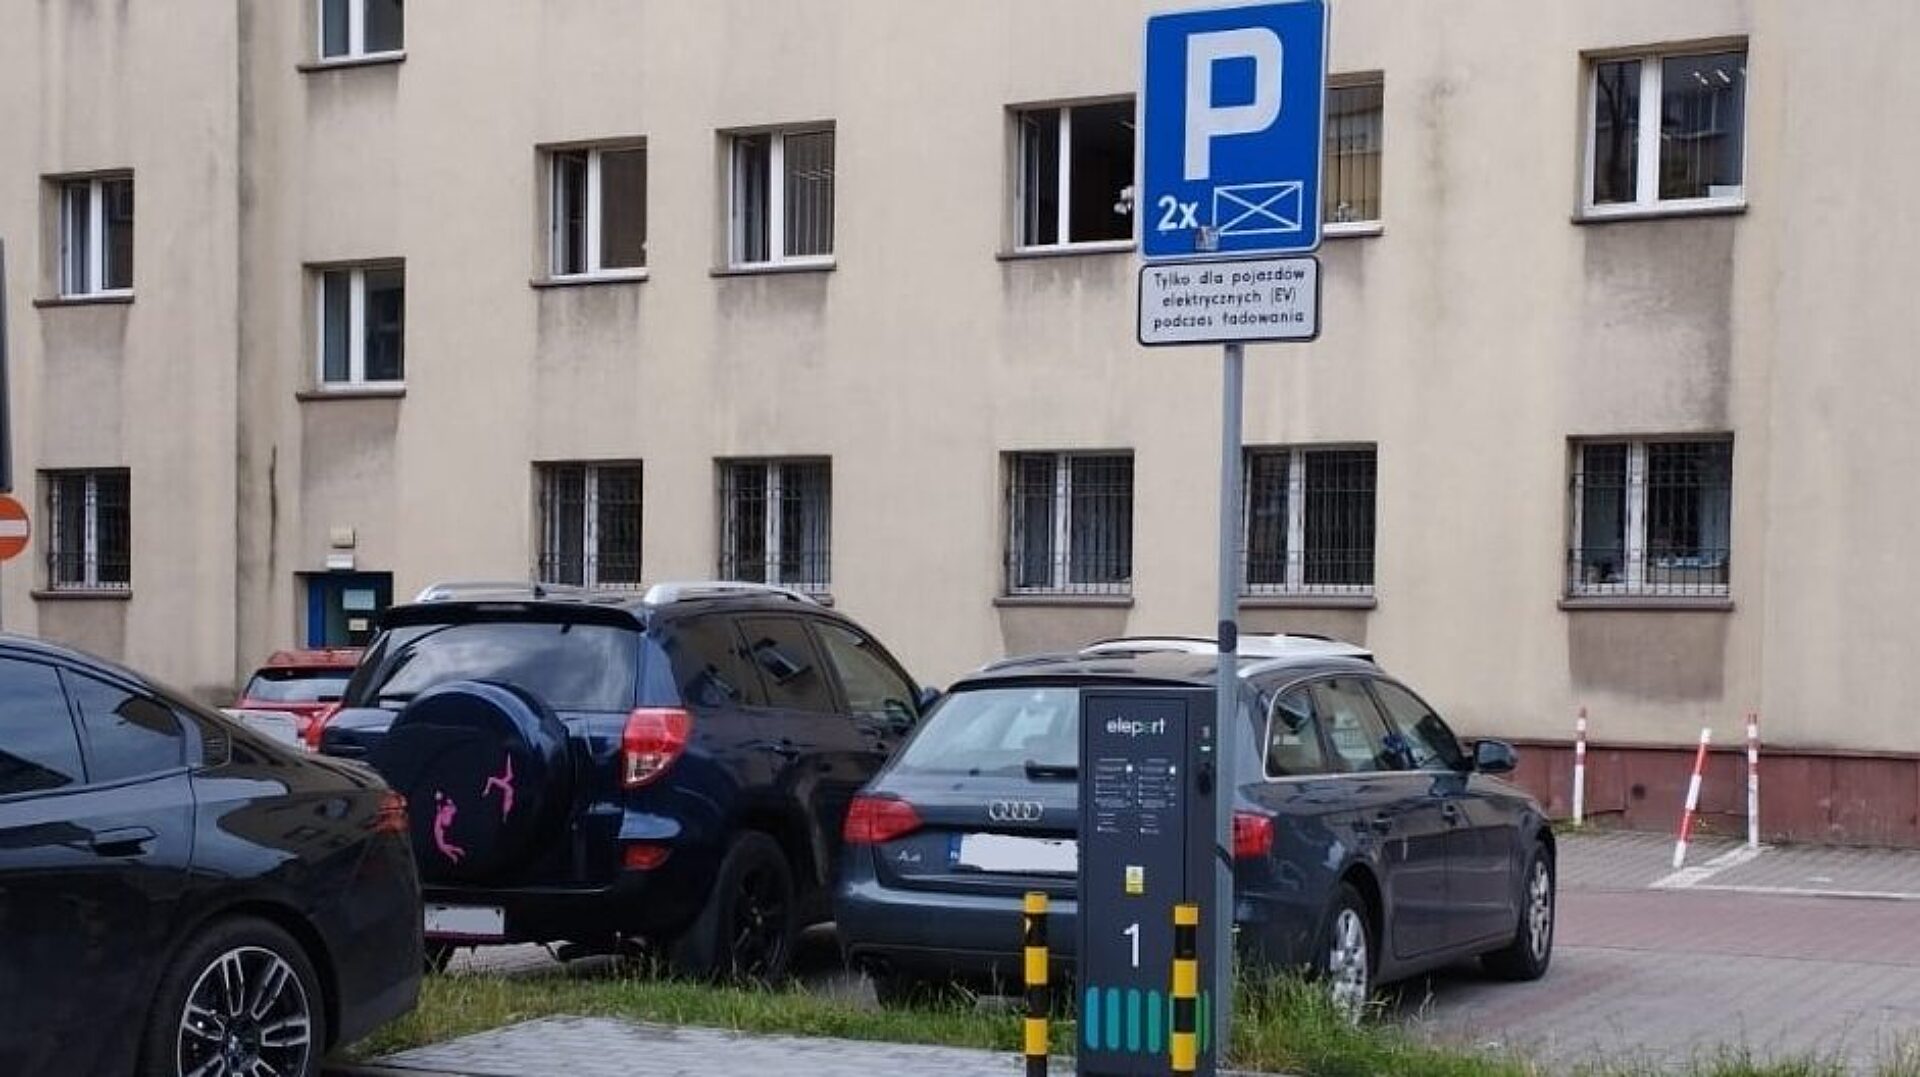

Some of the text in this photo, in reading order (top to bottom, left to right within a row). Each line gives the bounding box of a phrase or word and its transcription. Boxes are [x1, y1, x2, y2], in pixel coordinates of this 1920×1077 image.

[1184, 27, 1283, 180] P
[1157, 195, 1198, 231] 2x
[1154, 266, 1304, 290] Tylko dla pojazdów
[1163, 287, 1296, 308] elektrycznych (EV)
[1154, 310, 1304, 332] podczas ładowania
[1123, 923, 1140, 968] 1
